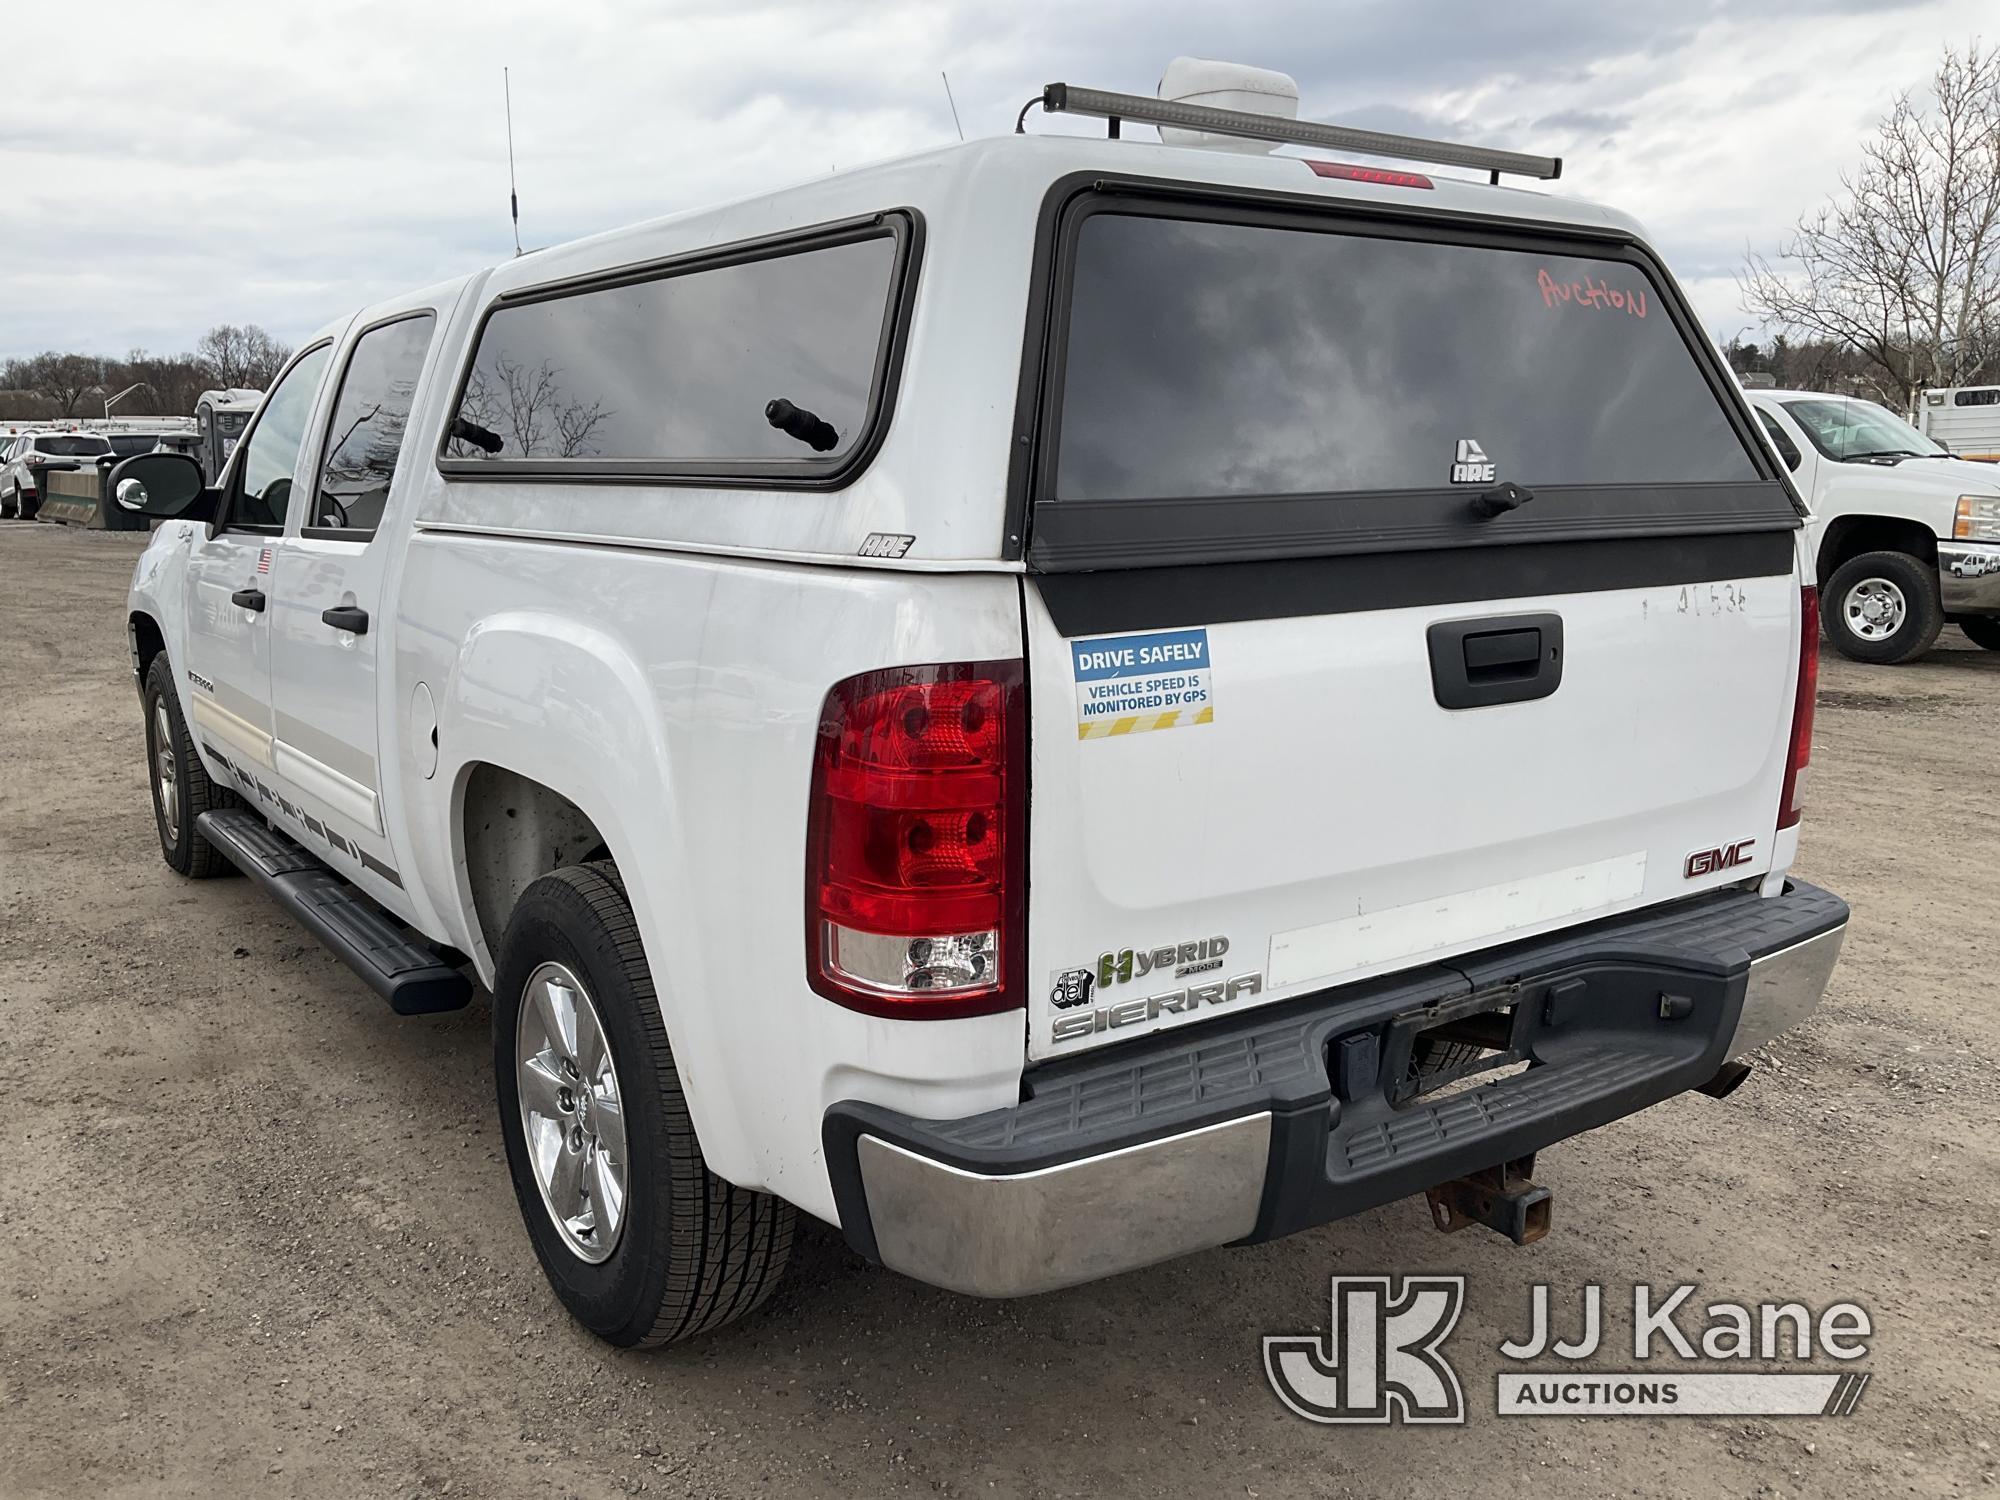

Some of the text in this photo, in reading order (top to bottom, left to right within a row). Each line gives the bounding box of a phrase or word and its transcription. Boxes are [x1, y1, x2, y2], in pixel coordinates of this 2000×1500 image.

[1451, 464, 1496, 484] ARE
[858, 533, 916, 558] ARE
[1078, 642, 1203, 671] DRIVE SAFELY
[1089, 675, 1200, 699] VEHICLE SPEED IS
[1083, 689, 1207, 716] MONITORED BY GPS
[1683, 836, 1756, 879] GMC
[1052, 970, 1263, 1044] SIERRA
